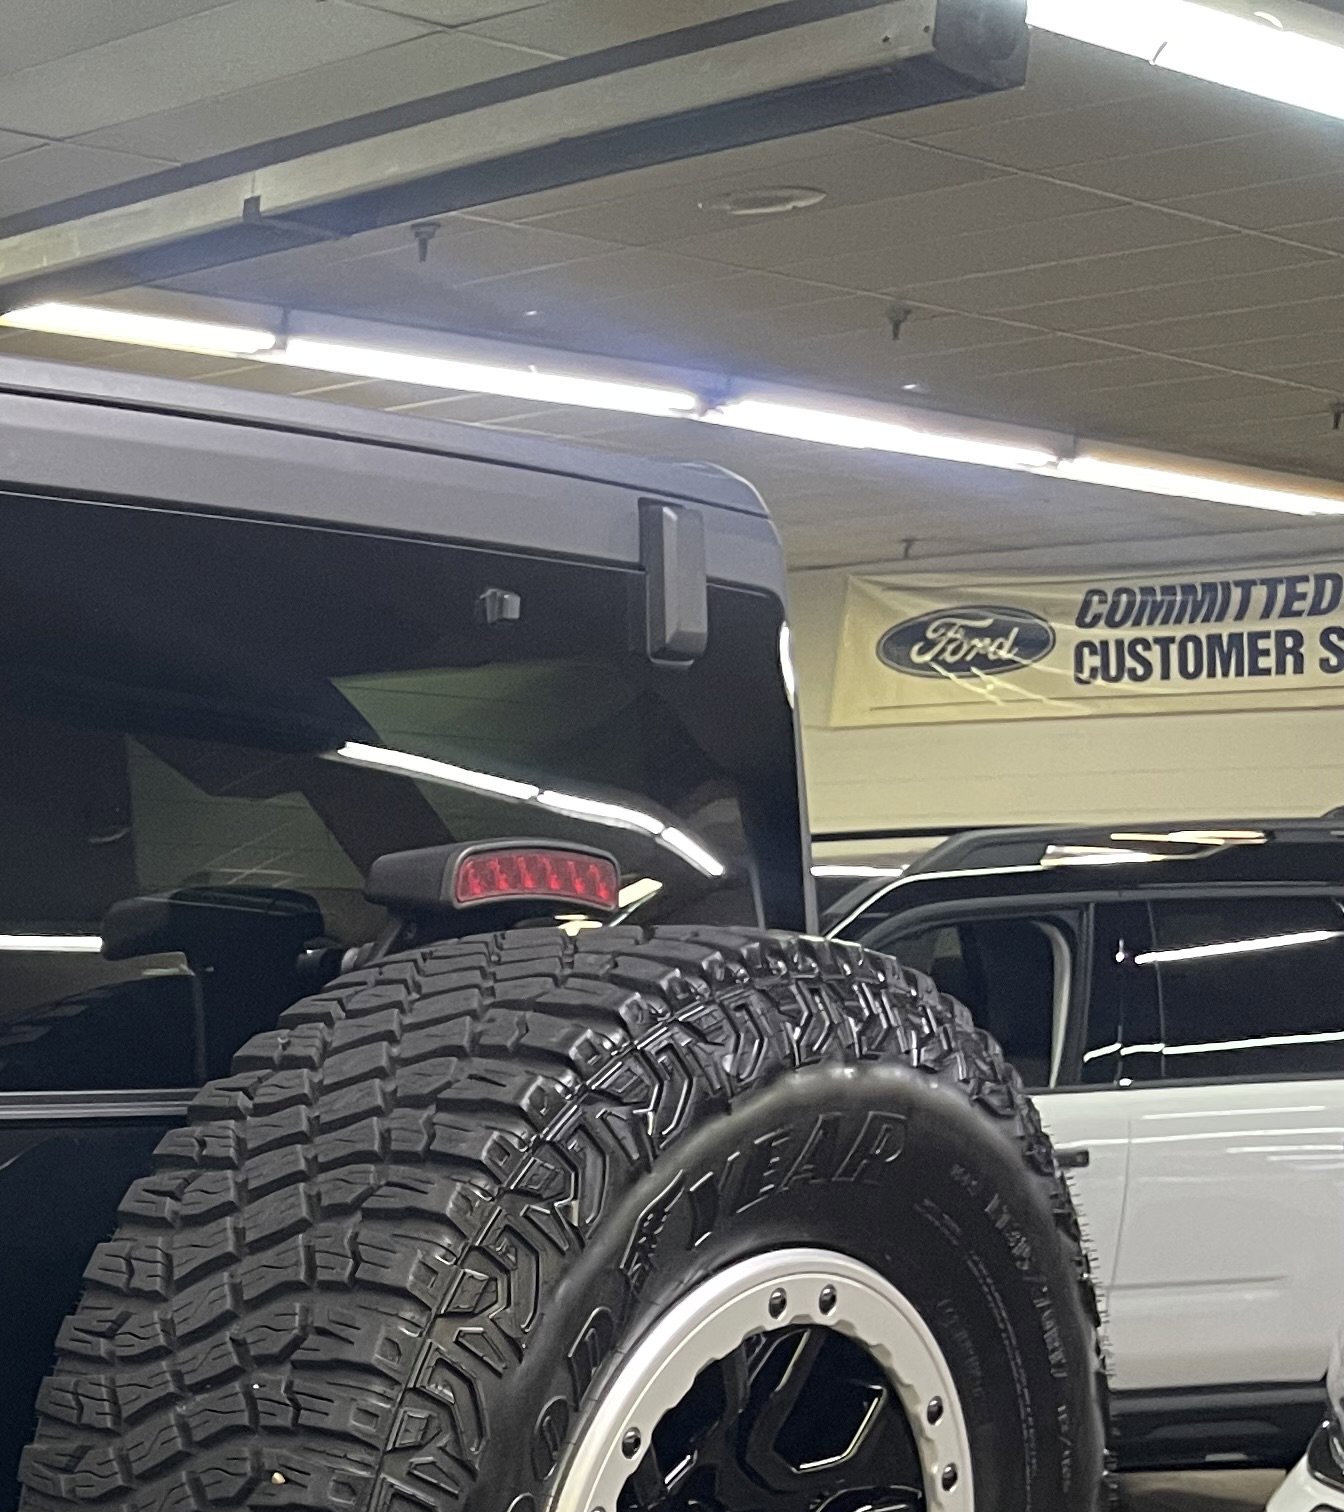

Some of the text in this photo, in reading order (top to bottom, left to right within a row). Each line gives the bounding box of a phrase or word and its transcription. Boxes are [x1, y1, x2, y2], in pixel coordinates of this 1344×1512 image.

[1075, 572, 1343, 629] COMMITTED
[911, 616, 1020, 665] Ford
[1073, 629, 1304, 685] CUSTOMER
